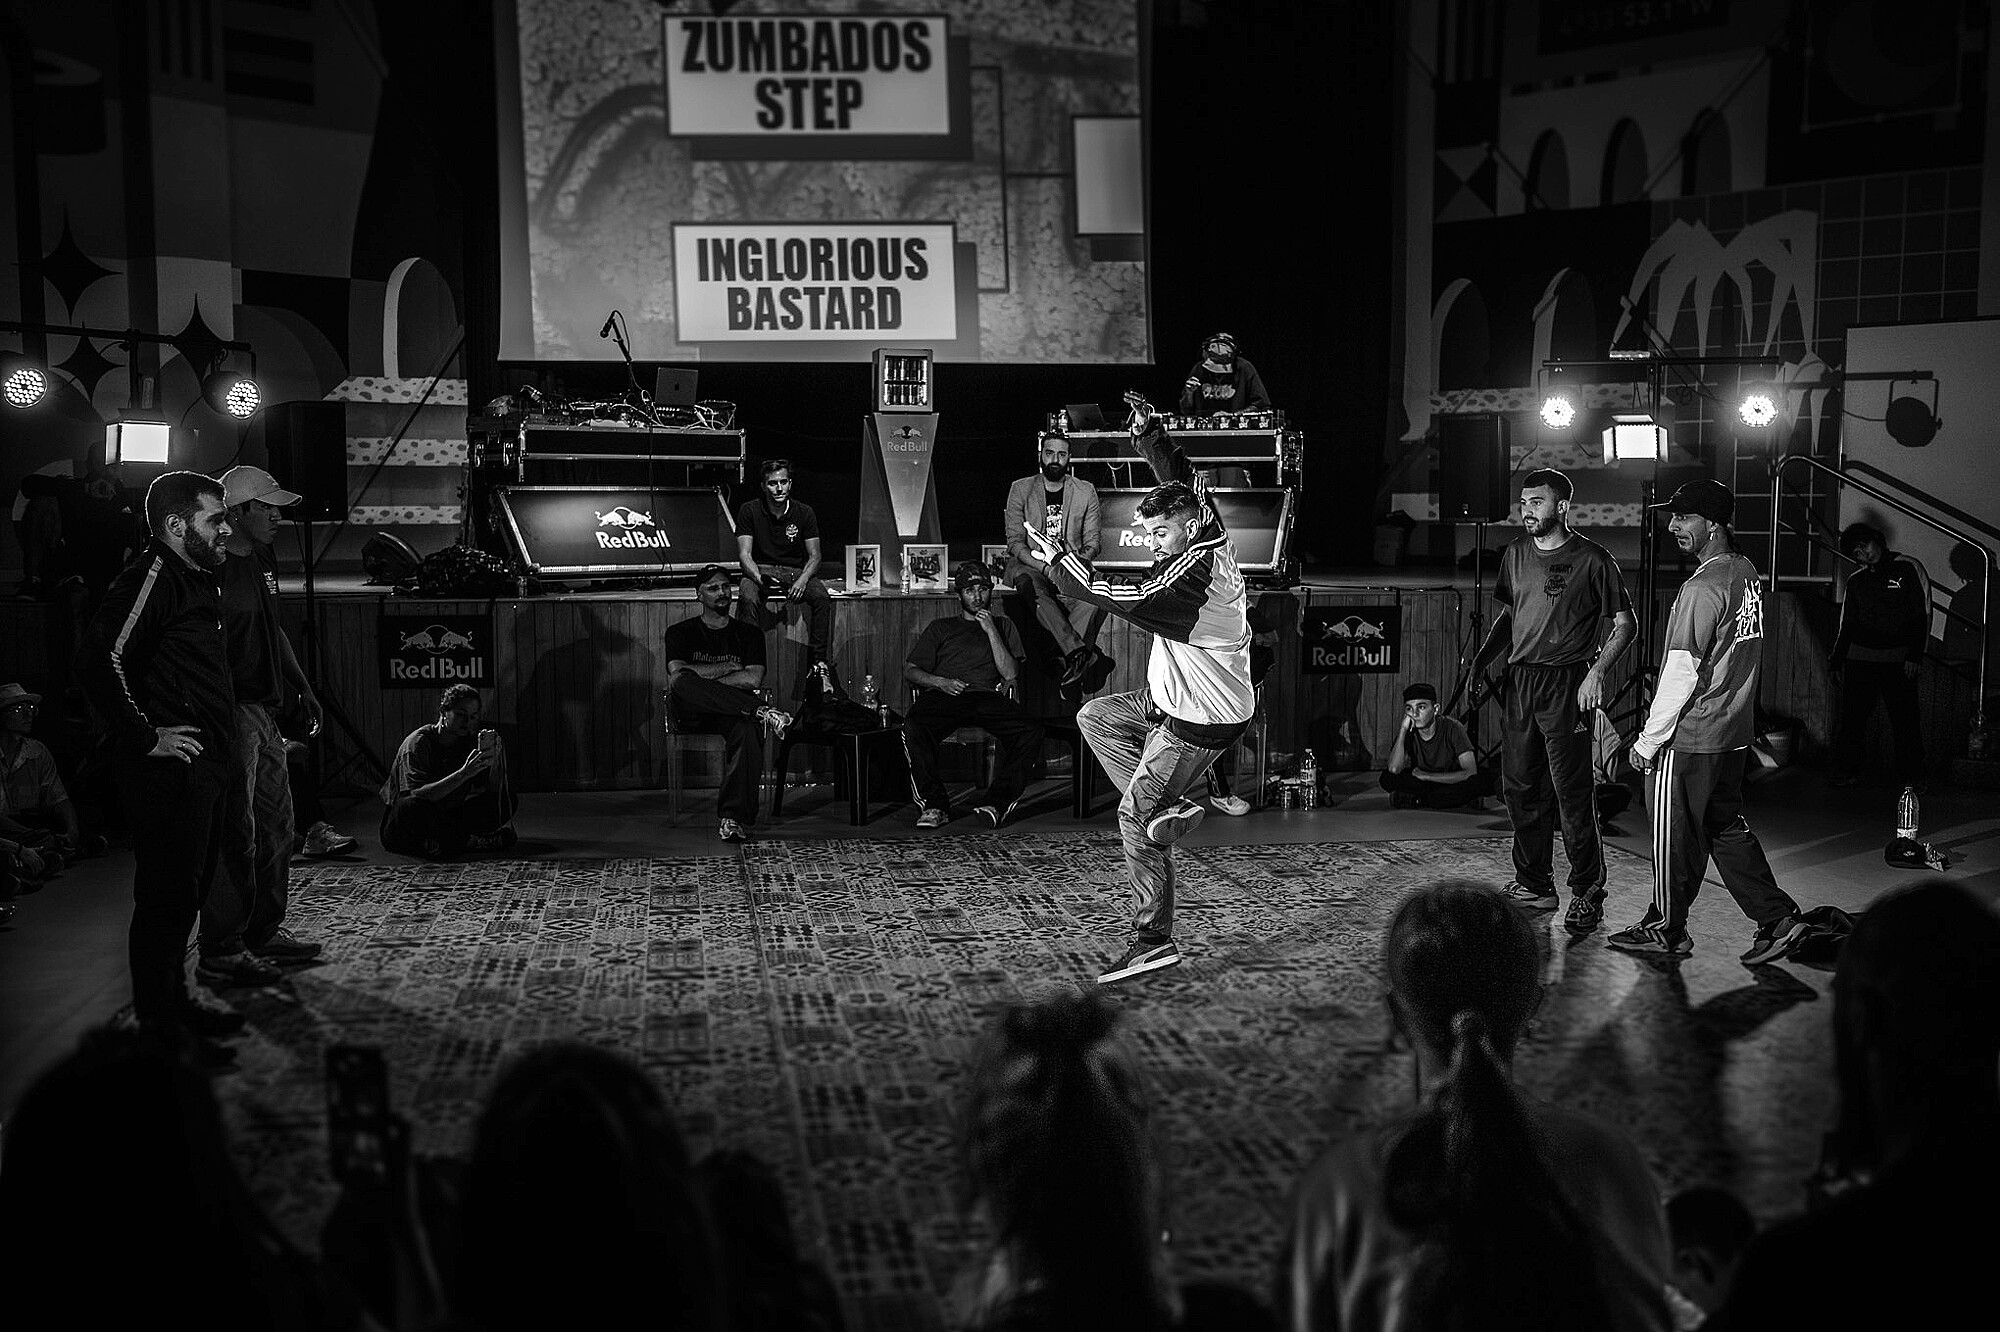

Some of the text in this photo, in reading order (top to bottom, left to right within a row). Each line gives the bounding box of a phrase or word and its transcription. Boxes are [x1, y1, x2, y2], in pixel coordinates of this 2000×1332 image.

[681, 20, 932, 73] ZUMBADOS
[755, 78, 863, 130] STEP
[697, 237, 929, 282] INGLORIOUS
[727, 286, 902, 331] BASTARD
[887, 441, 928, 452] Red Bull
[595, 529, 672, 549] Red Bull
[390, 657, 483, 679] Red Bull
[1312, 645, 1391, 666] Red Bull
